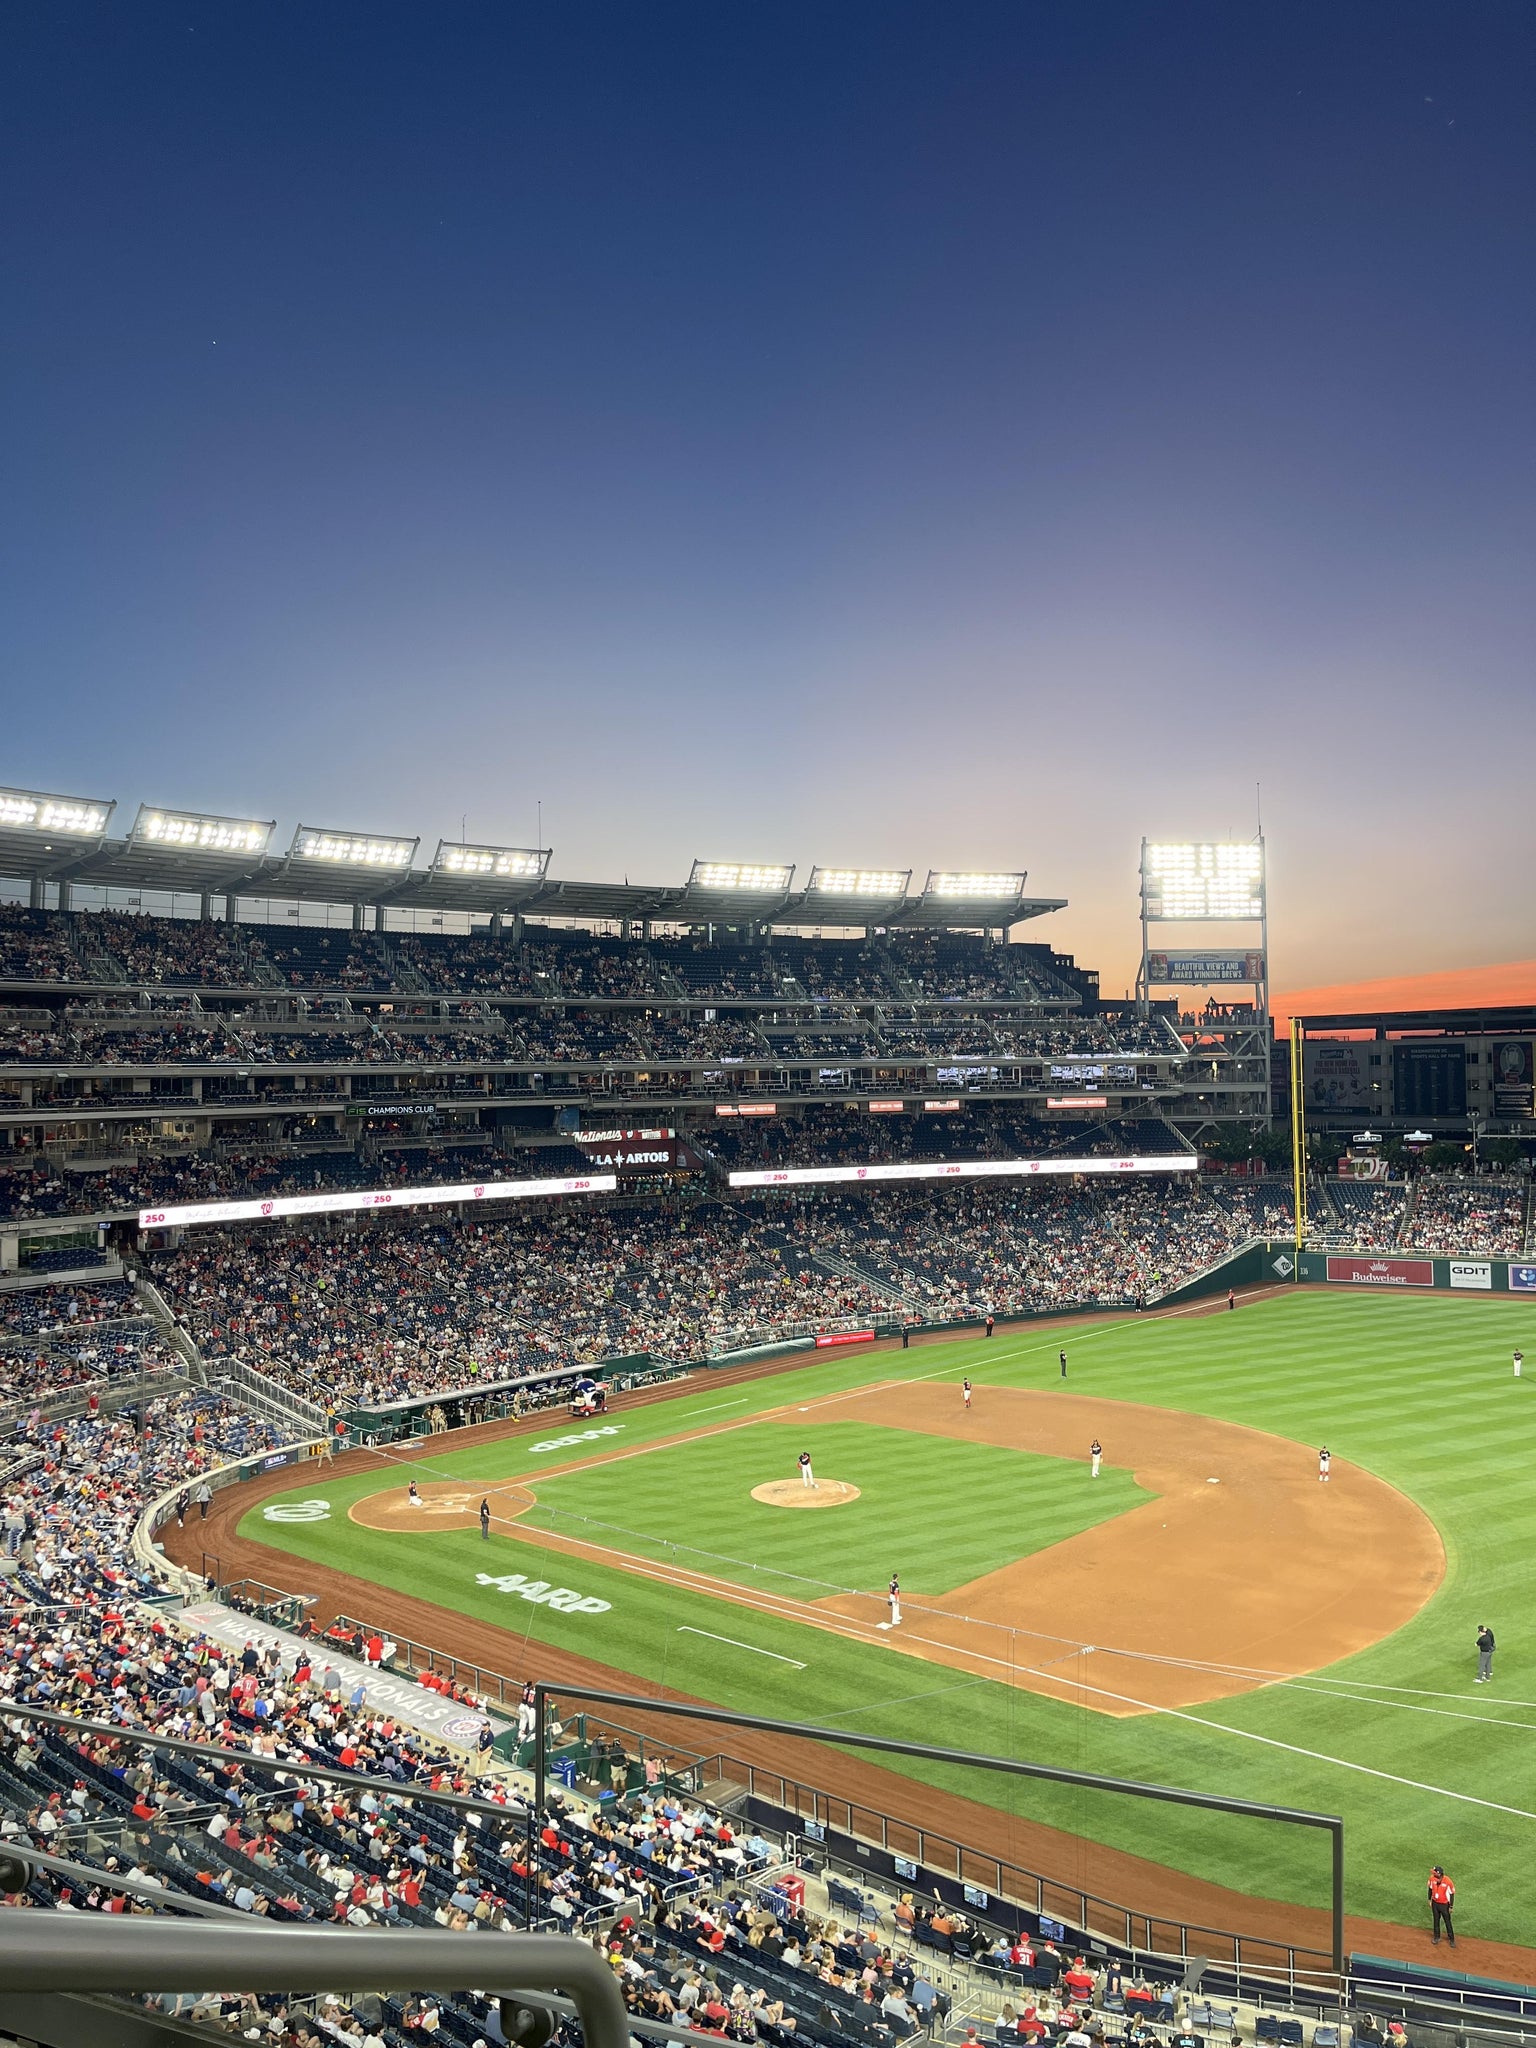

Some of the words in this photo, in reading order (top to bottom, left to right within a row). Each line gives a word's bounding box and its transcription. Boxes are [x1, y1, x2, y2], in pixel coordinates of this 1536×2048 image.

[1174, 962, 1205, 971] BEAUTIFUL
[1206, 962, 1225, 971] VIEWS
[1226, 962, 1239, 971] AND
[1171, 970, 1194, 979] AWARD
[1194, 970, 1221, 979] WINNING
[1221, 970, 1242, 979] BREWS
[368, 1106, 414, 1115] CHAMPIONS
[415, 1105, 435, 1113] CLUB
[573, 1130, 623, 1143] Nationals
[626, 1151, 670, 1164] ARTOIS
[946, 1166, 960, 1174] 250
[1119, 1161, 1134, 1169] 250
[574, 1180, 590, 1189] 250
[374, 1194, 392, 1204] 250
[145, 1213, 165, 1224] 250
[1451, 1266, 1489, 1275] GDIT
[527, 1424, 627, 1453] AARP
[475, 1572, 612, 1614] AARP
[1018, 1953, 1031, 1966] 31
